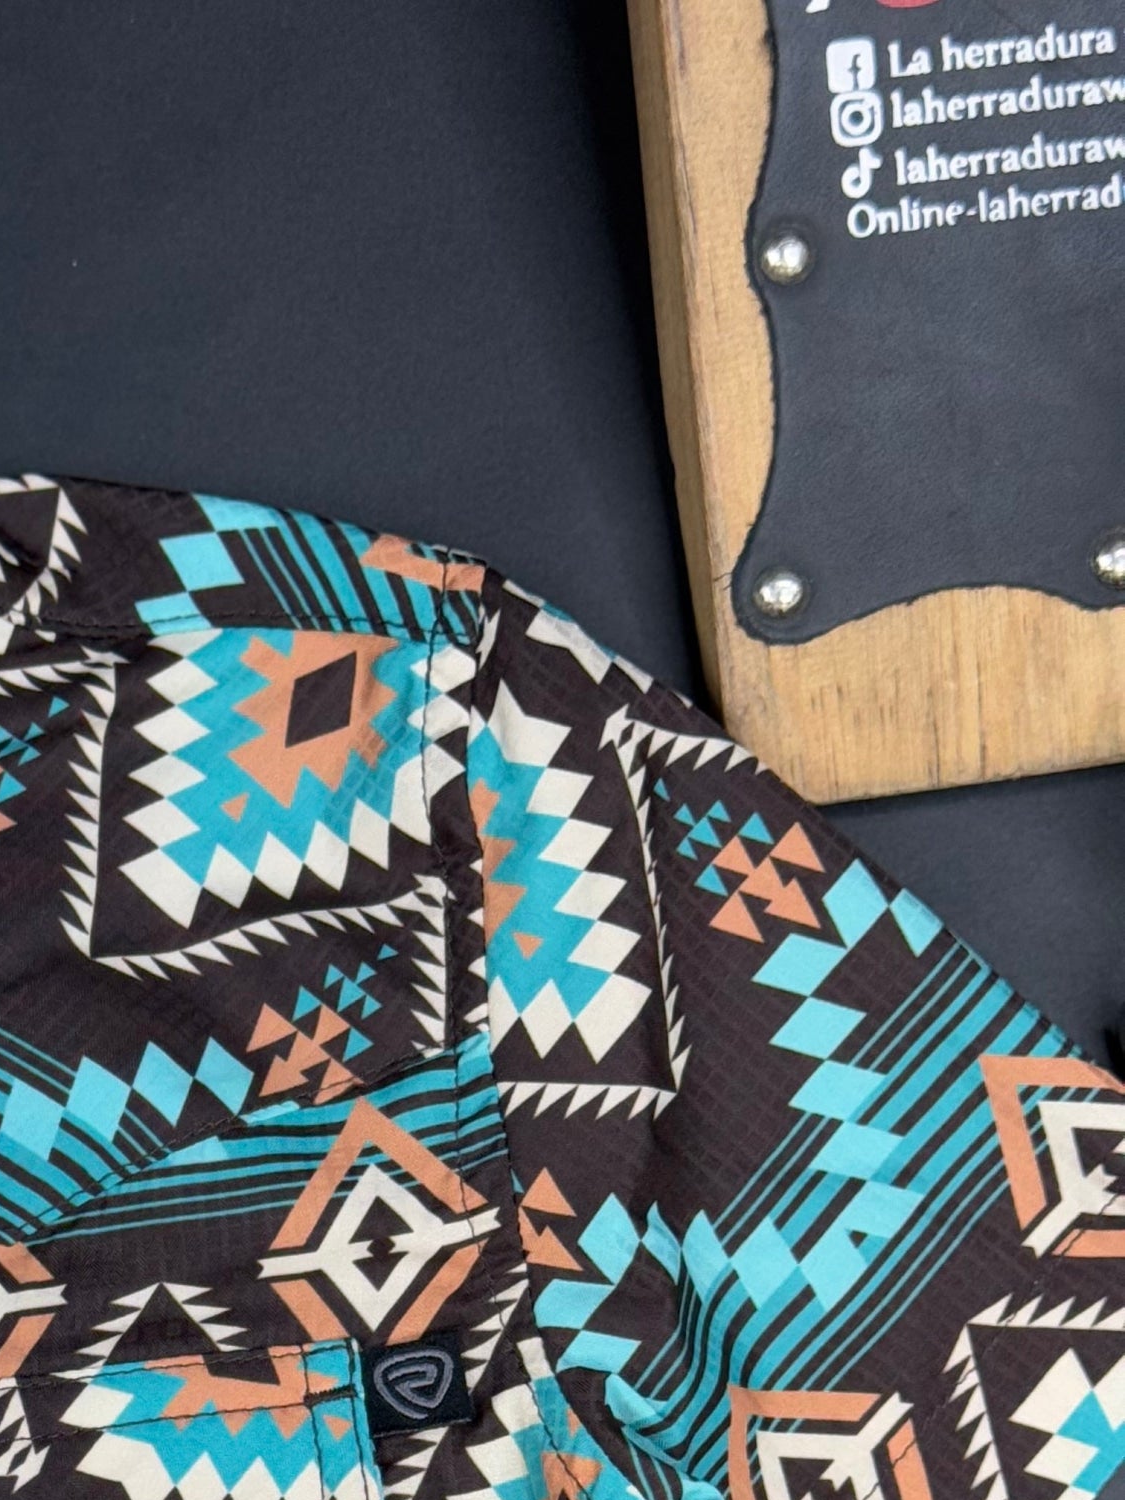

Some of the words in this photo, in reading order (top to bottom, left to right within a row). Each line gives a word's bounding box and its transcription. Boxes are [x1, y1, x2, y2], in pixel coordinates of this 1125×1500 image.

[888, 40, 933, 78] La
[941, 22, 1117, 72] herradura
[890, 73, 1125, 128] laherraduraw
[895, 130, 1125, 186] laherraduraw
[846, 171, 1125, 238] Online-laherrad
